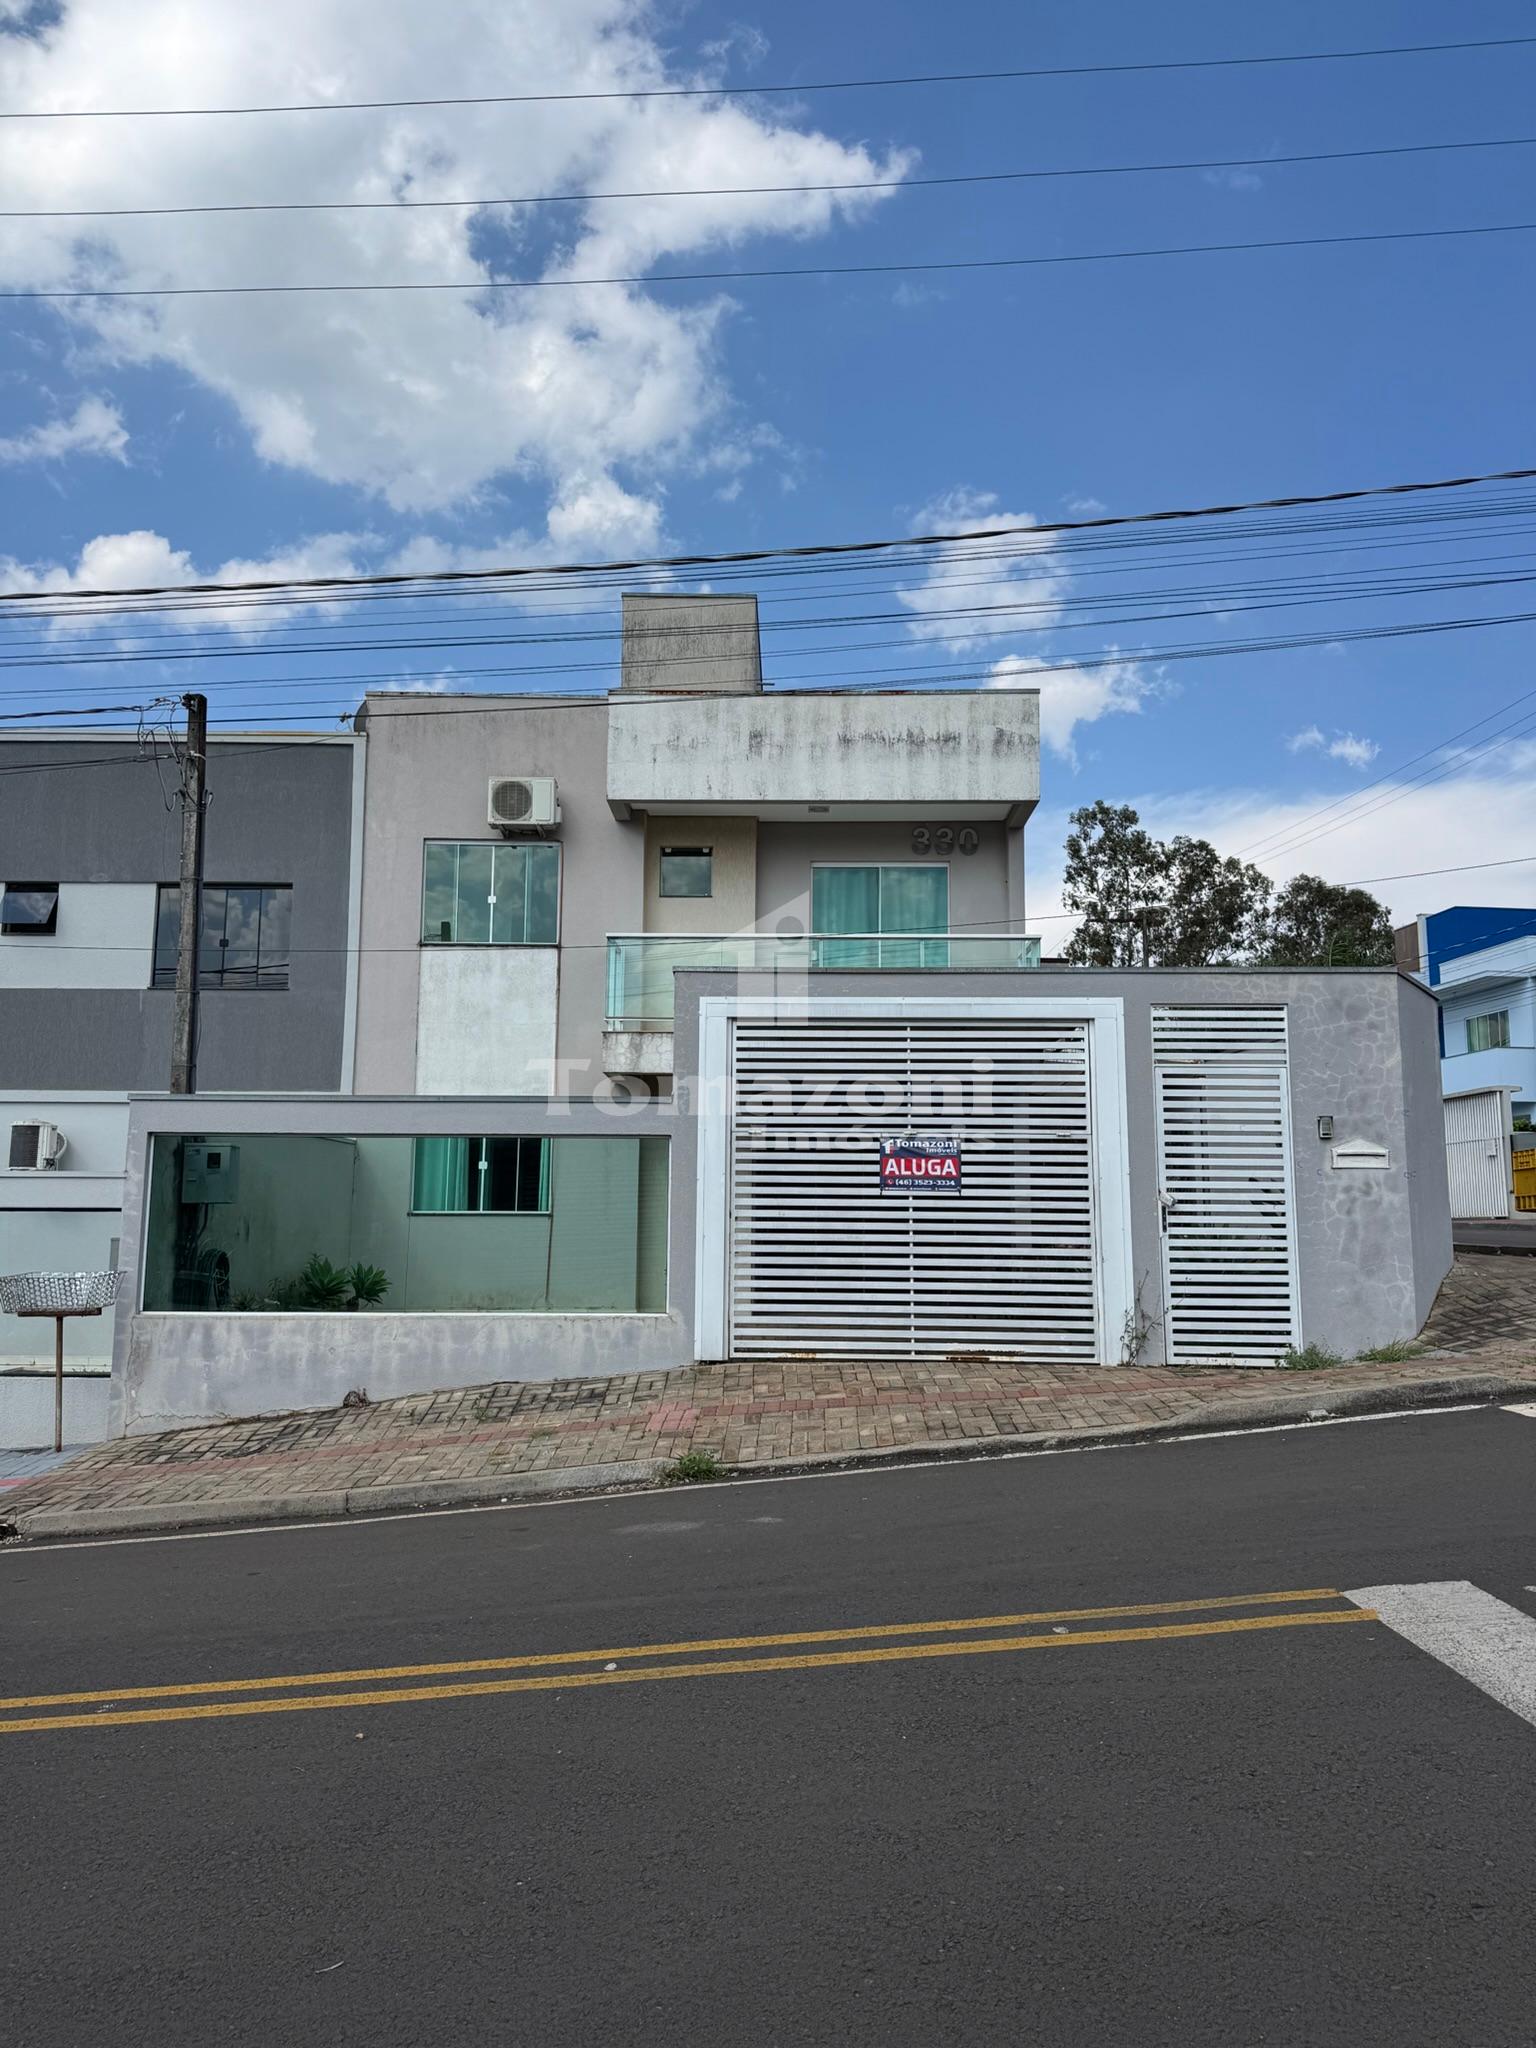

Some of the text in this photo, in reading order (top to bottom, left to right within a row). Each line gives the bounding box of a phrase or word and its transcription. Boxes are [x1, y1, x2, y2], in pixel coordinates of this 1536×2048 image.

[912, 827, 979, 856] 330
[894, 1138, 957, 1148] Tomazoni
[884, 1158, 957, 1176] ALUGA
[895, 1178, 912, 1186] (46)
